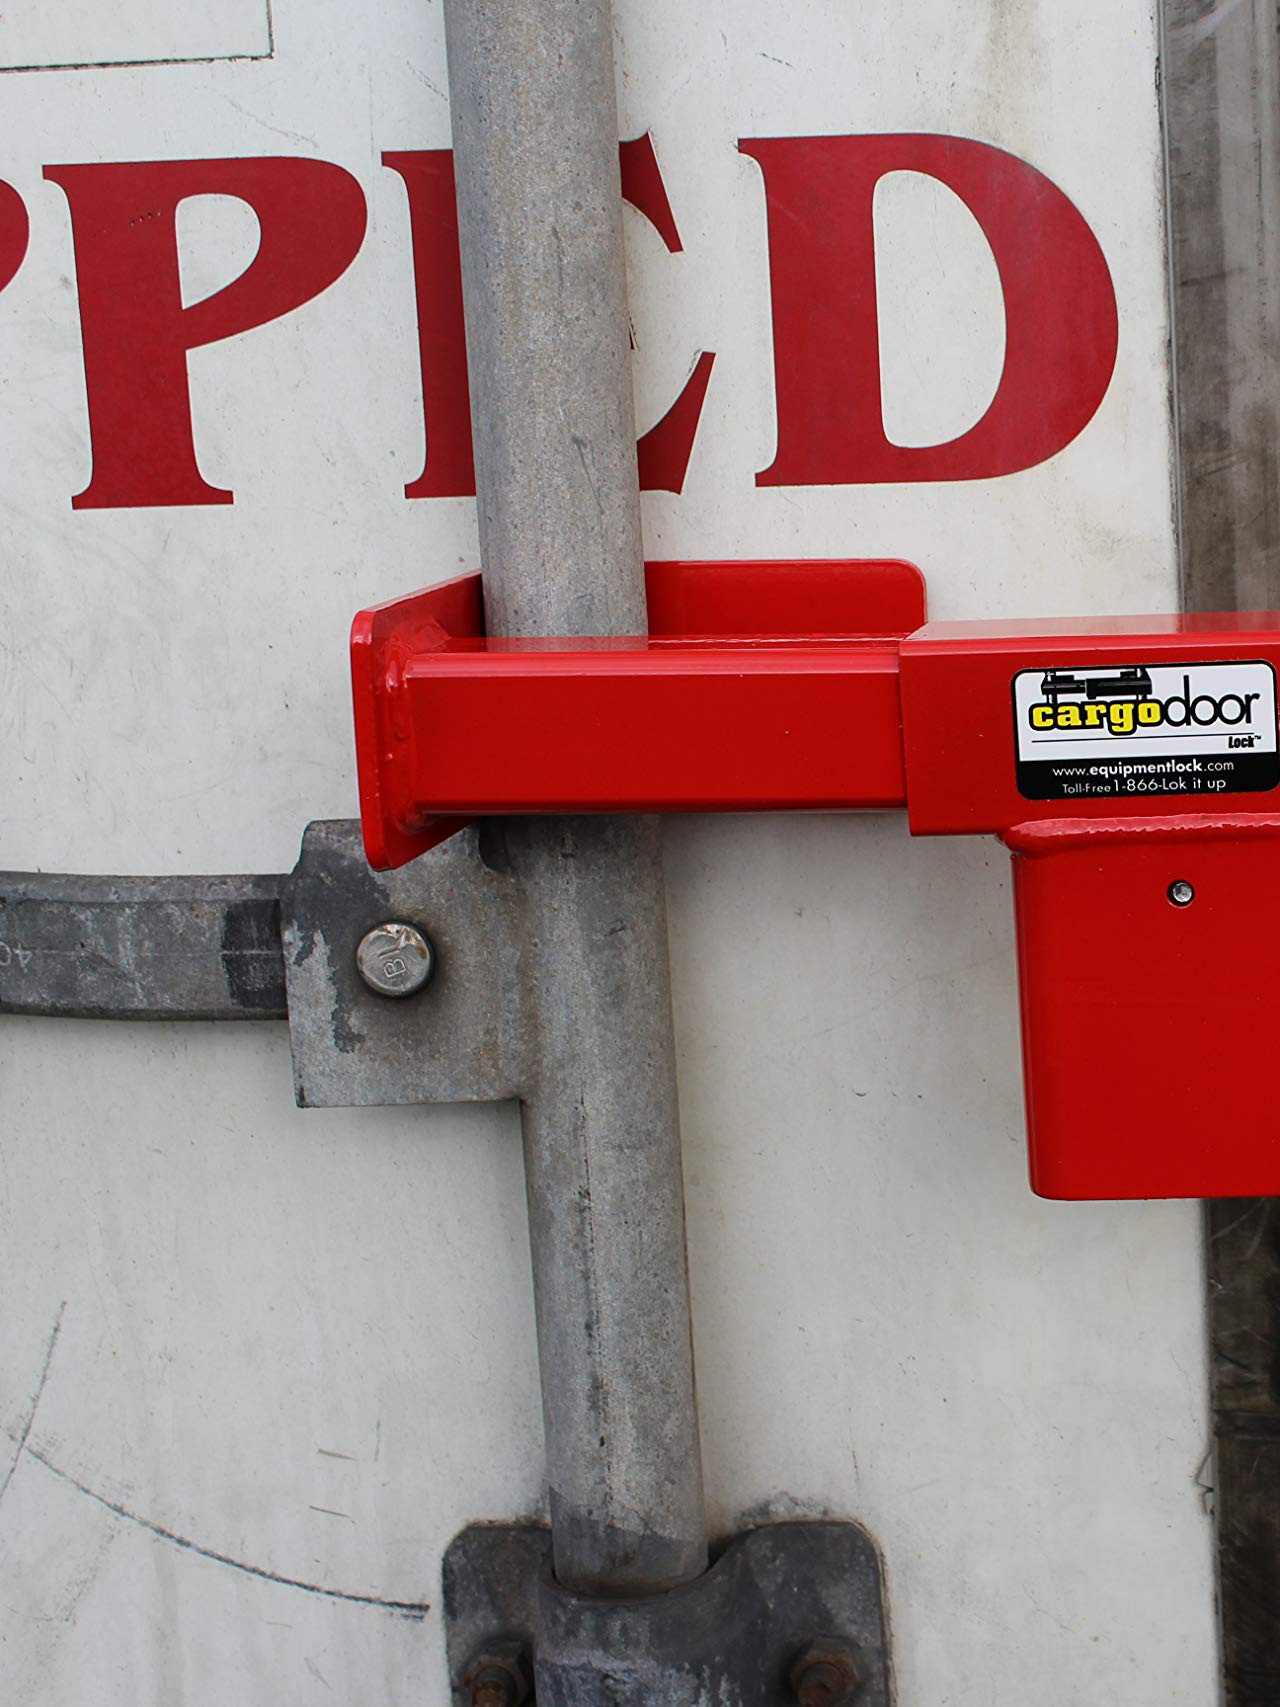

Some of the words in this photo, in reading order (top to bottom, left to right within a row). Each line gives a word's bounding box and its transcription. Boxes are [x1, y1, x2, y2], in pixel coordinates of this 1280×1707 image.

[1052, 758, 1234, 778] www.equipmentlock.com
[1113, 776, 1187, 792] 1-866-Lok
[1192, 777, 1201, 789] it
[1207, 779, 1227, 792] up
